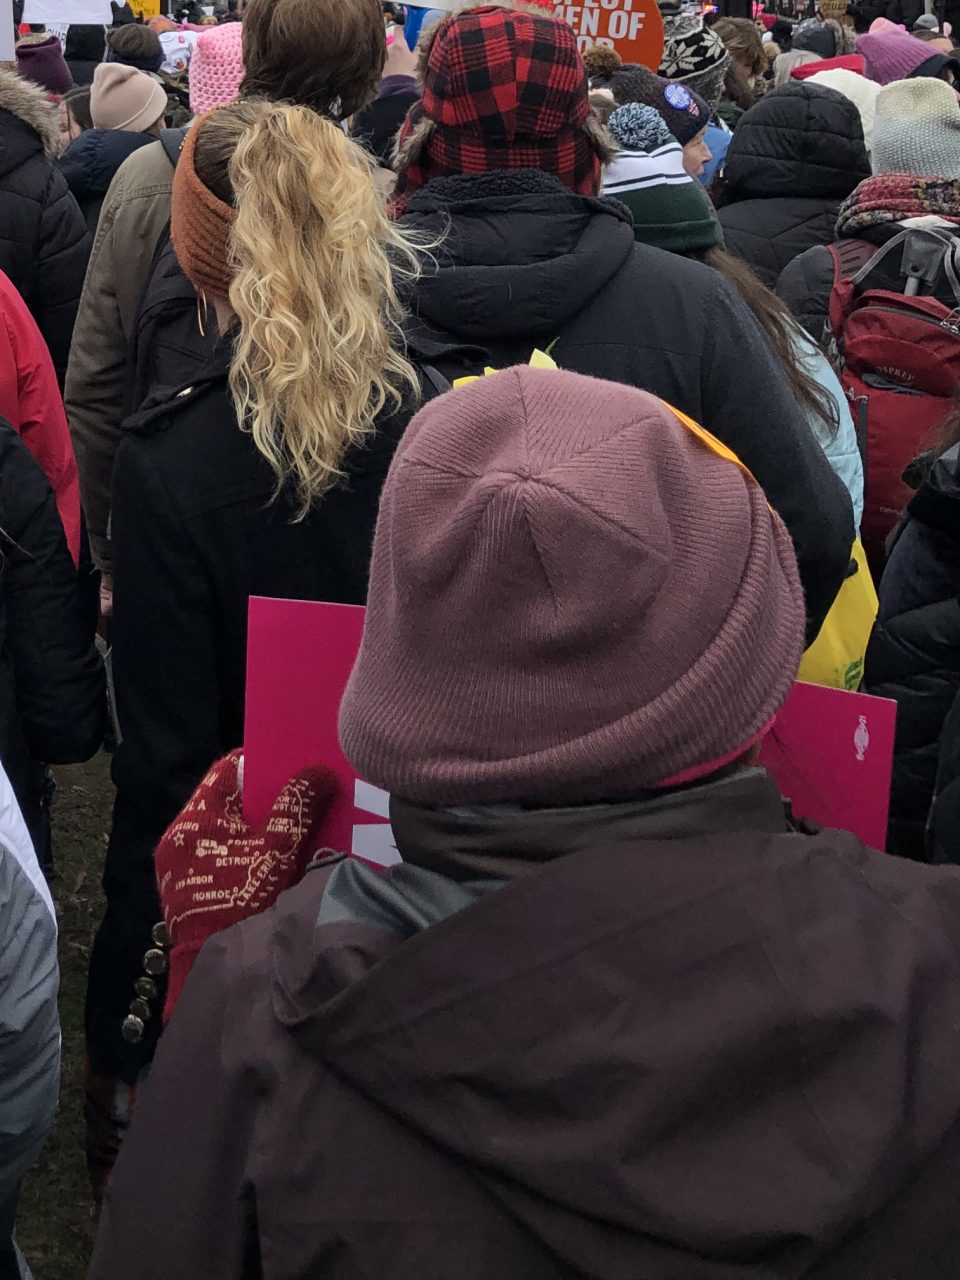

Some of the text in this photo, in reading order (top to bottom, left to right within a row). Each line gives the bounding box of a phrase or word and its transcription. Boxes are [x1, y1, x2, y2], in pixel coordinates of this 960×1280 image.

[607, 10, 646, 40] OF
[215, 856, 255, 867] DETROIT
[186, 874, 214, 886] ARBOR
[192, 889, 231, 901] MONROE
